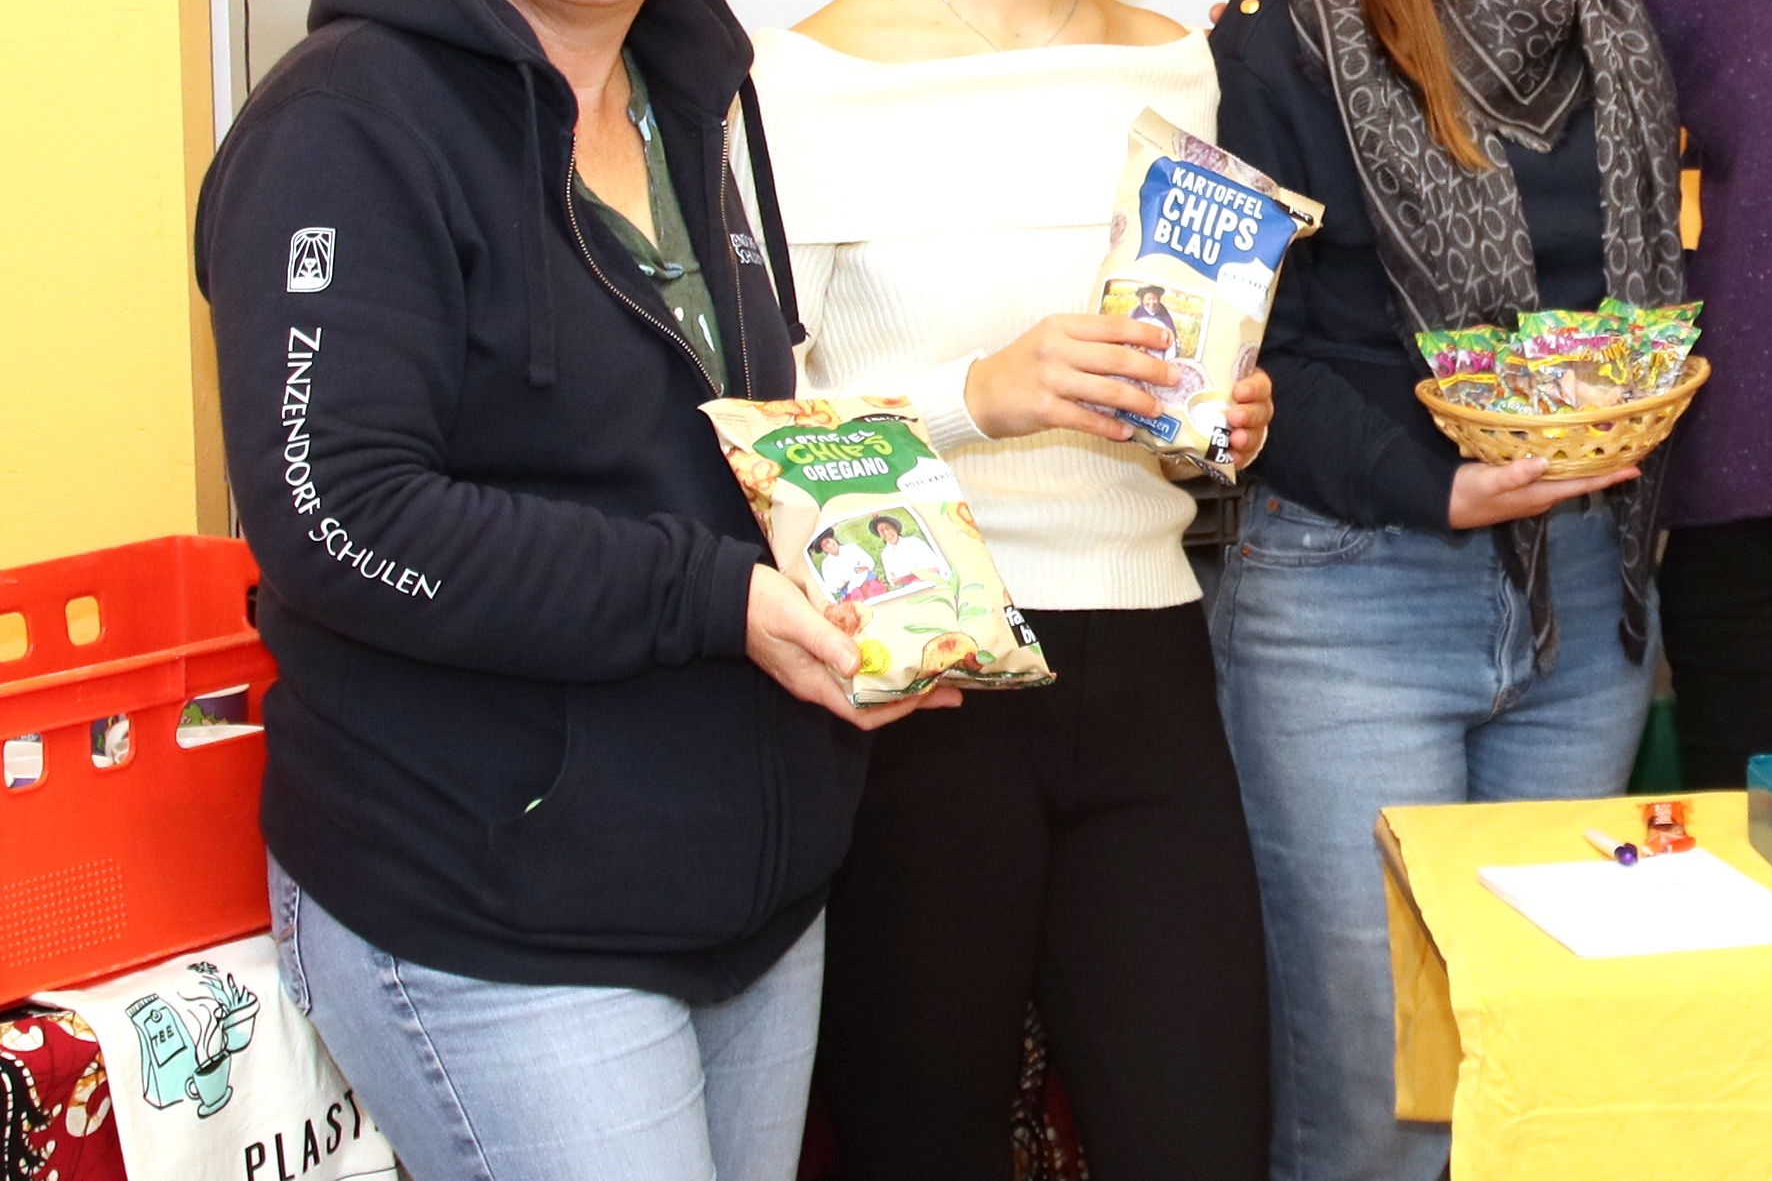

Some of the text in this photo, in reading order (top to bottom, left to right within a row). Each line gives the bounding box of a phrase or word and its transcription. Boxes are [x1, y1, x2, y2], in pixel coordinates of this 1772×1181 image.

[1162, 187, 1259, 251] CHIPS
[1172, 166, 1263, 220] KARTOFFEL
[1153, 217, 1221, 265] BLAU
[281, 326, 323, 516] ZINZENDORF
[786, 435, 894, 465] CHIPS
[802, 456, 891, 482] OREGANO
[308, 517, 442, 600] SCHULEN
[151, 1024, 175, 1048] TEE
[244, 1088, 378, 1181] PLAST
